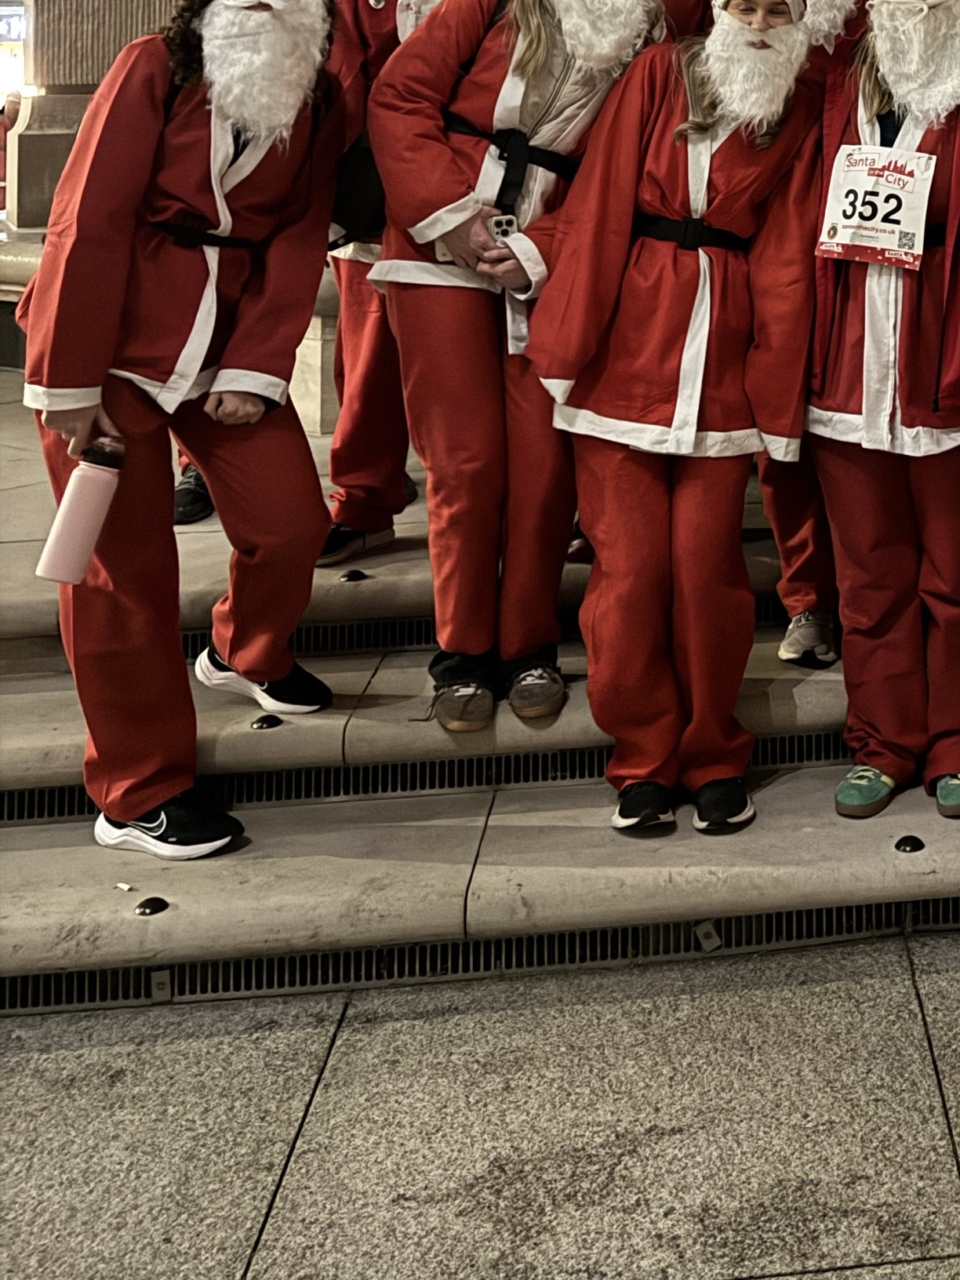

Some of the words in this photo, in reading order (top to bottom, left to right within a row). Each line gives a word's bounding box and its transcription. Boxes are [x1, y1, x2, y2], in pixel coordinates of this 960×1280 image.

[846, 155, 876, 168] Santa
[885, 173, 909, 189] City
[842, 189, 903, 225] 352
